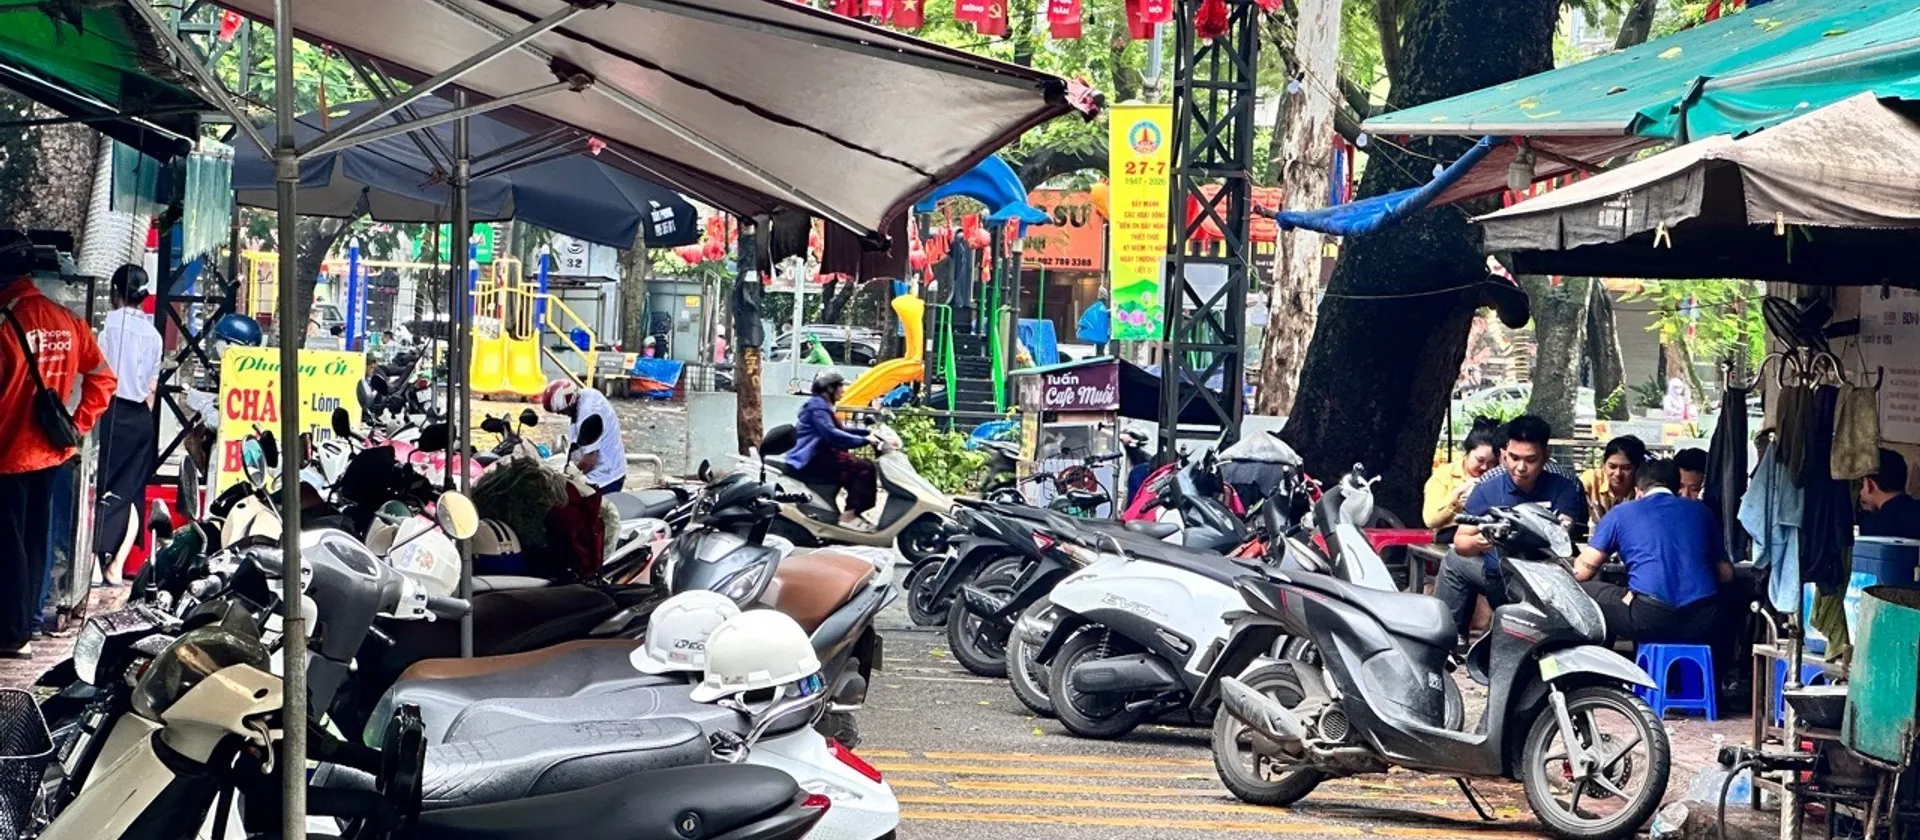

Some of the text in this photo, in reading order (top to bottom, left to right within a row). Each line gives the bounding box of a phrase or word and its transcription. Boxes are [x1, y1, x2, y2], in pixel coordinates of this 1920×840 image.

[567, 258, 582, 268] 32
[1047, 371, 1080, 386] Tuấn
[227, 380, 283, 422] CHÁ
[1045, 386, 1076, 408] Cafe
